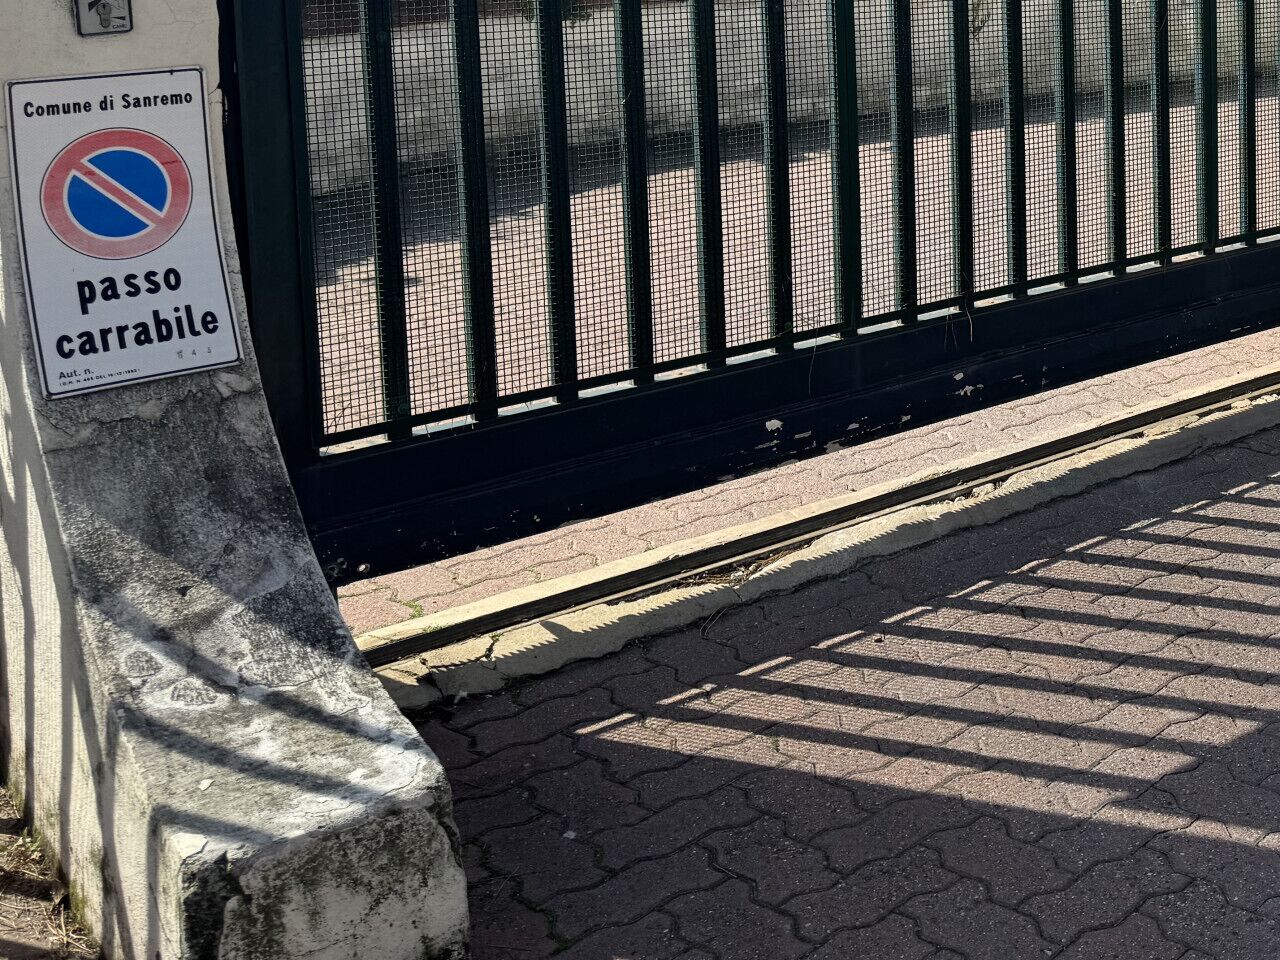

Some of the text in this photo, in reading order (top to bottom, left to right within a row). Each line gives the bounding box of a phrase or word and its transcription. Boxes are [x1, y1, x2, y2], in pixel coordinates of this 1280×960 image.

[24, 92, 193, 118] Comune di Sanremo
[77, 267, 182, 315] passo
[56, 304, 219, 359] carrabile
[59, 367, 94, 380] Aut. n.
